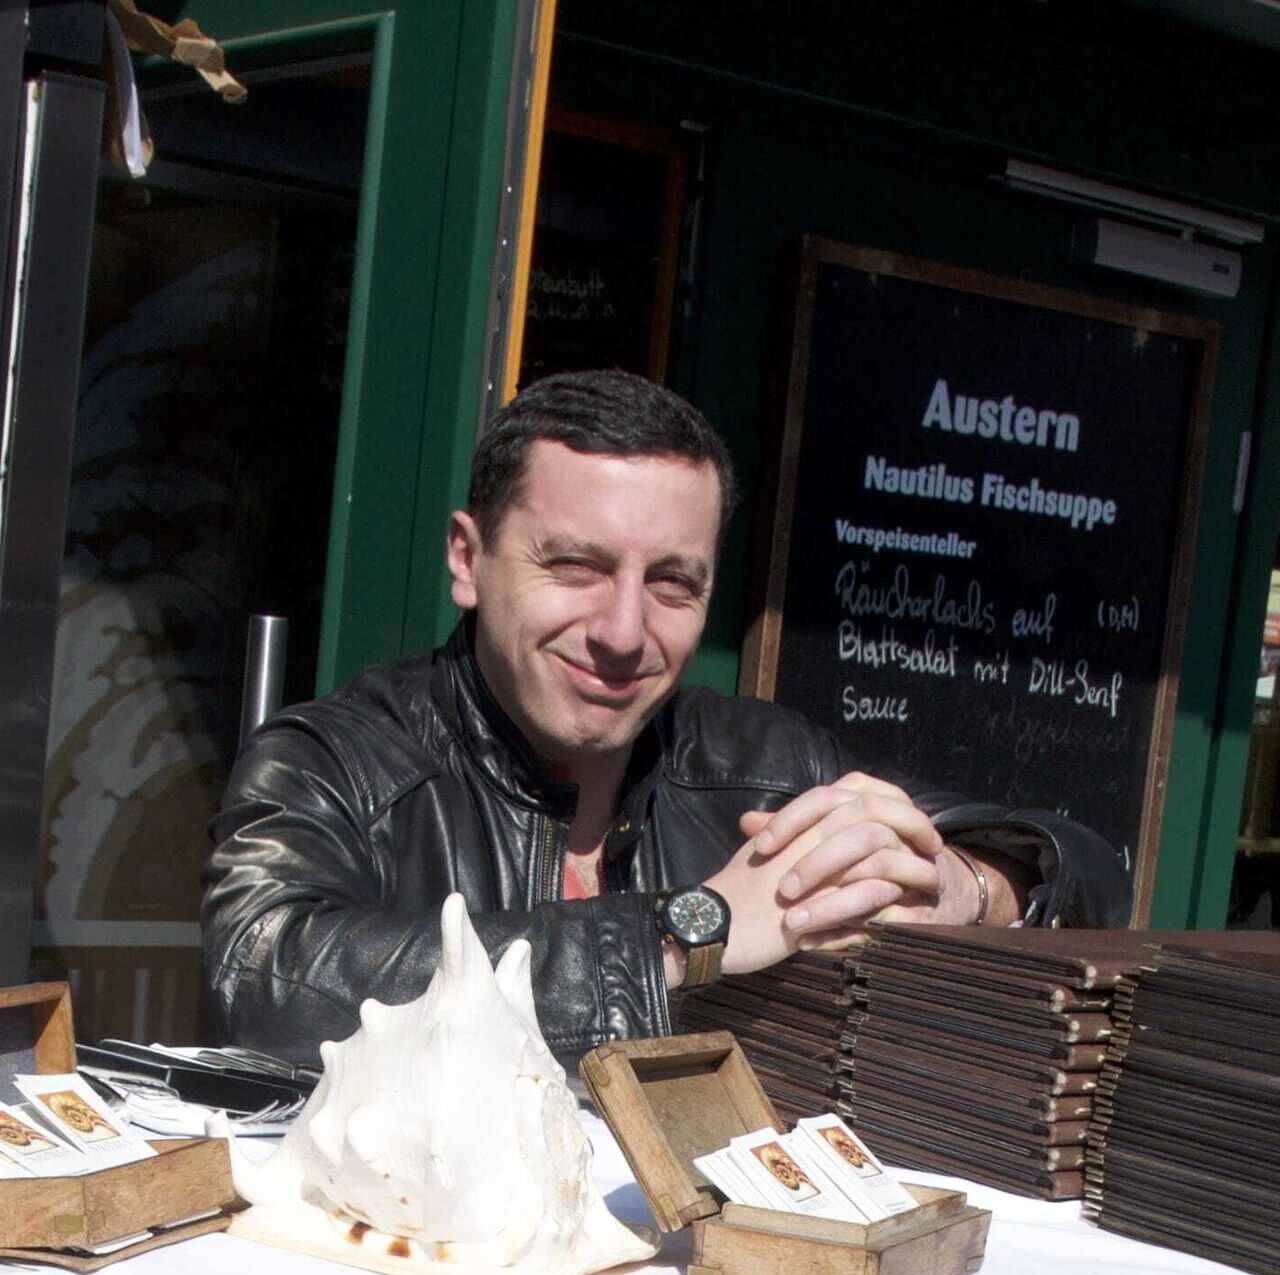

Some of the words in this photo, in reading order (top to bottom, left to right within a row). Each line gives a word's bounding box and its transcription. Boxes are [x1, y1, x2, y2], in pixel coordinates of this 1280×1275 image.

[922, 378, 1080, 452] Austern
[864, 455, 975, 504] Nautilus
[980, 472, 1117, 531] Fischsuppe
[834, 518, 977, 559] Vorspeisenteller
[1010, 592, 1057, 644] auf
[837, 619, 959, 677] Blattsalat
[973, 651, 1010, 685] mit
[1028, 655, 1123, 718] Dill-Senf
[842, 685, 909, 721] Sauce
